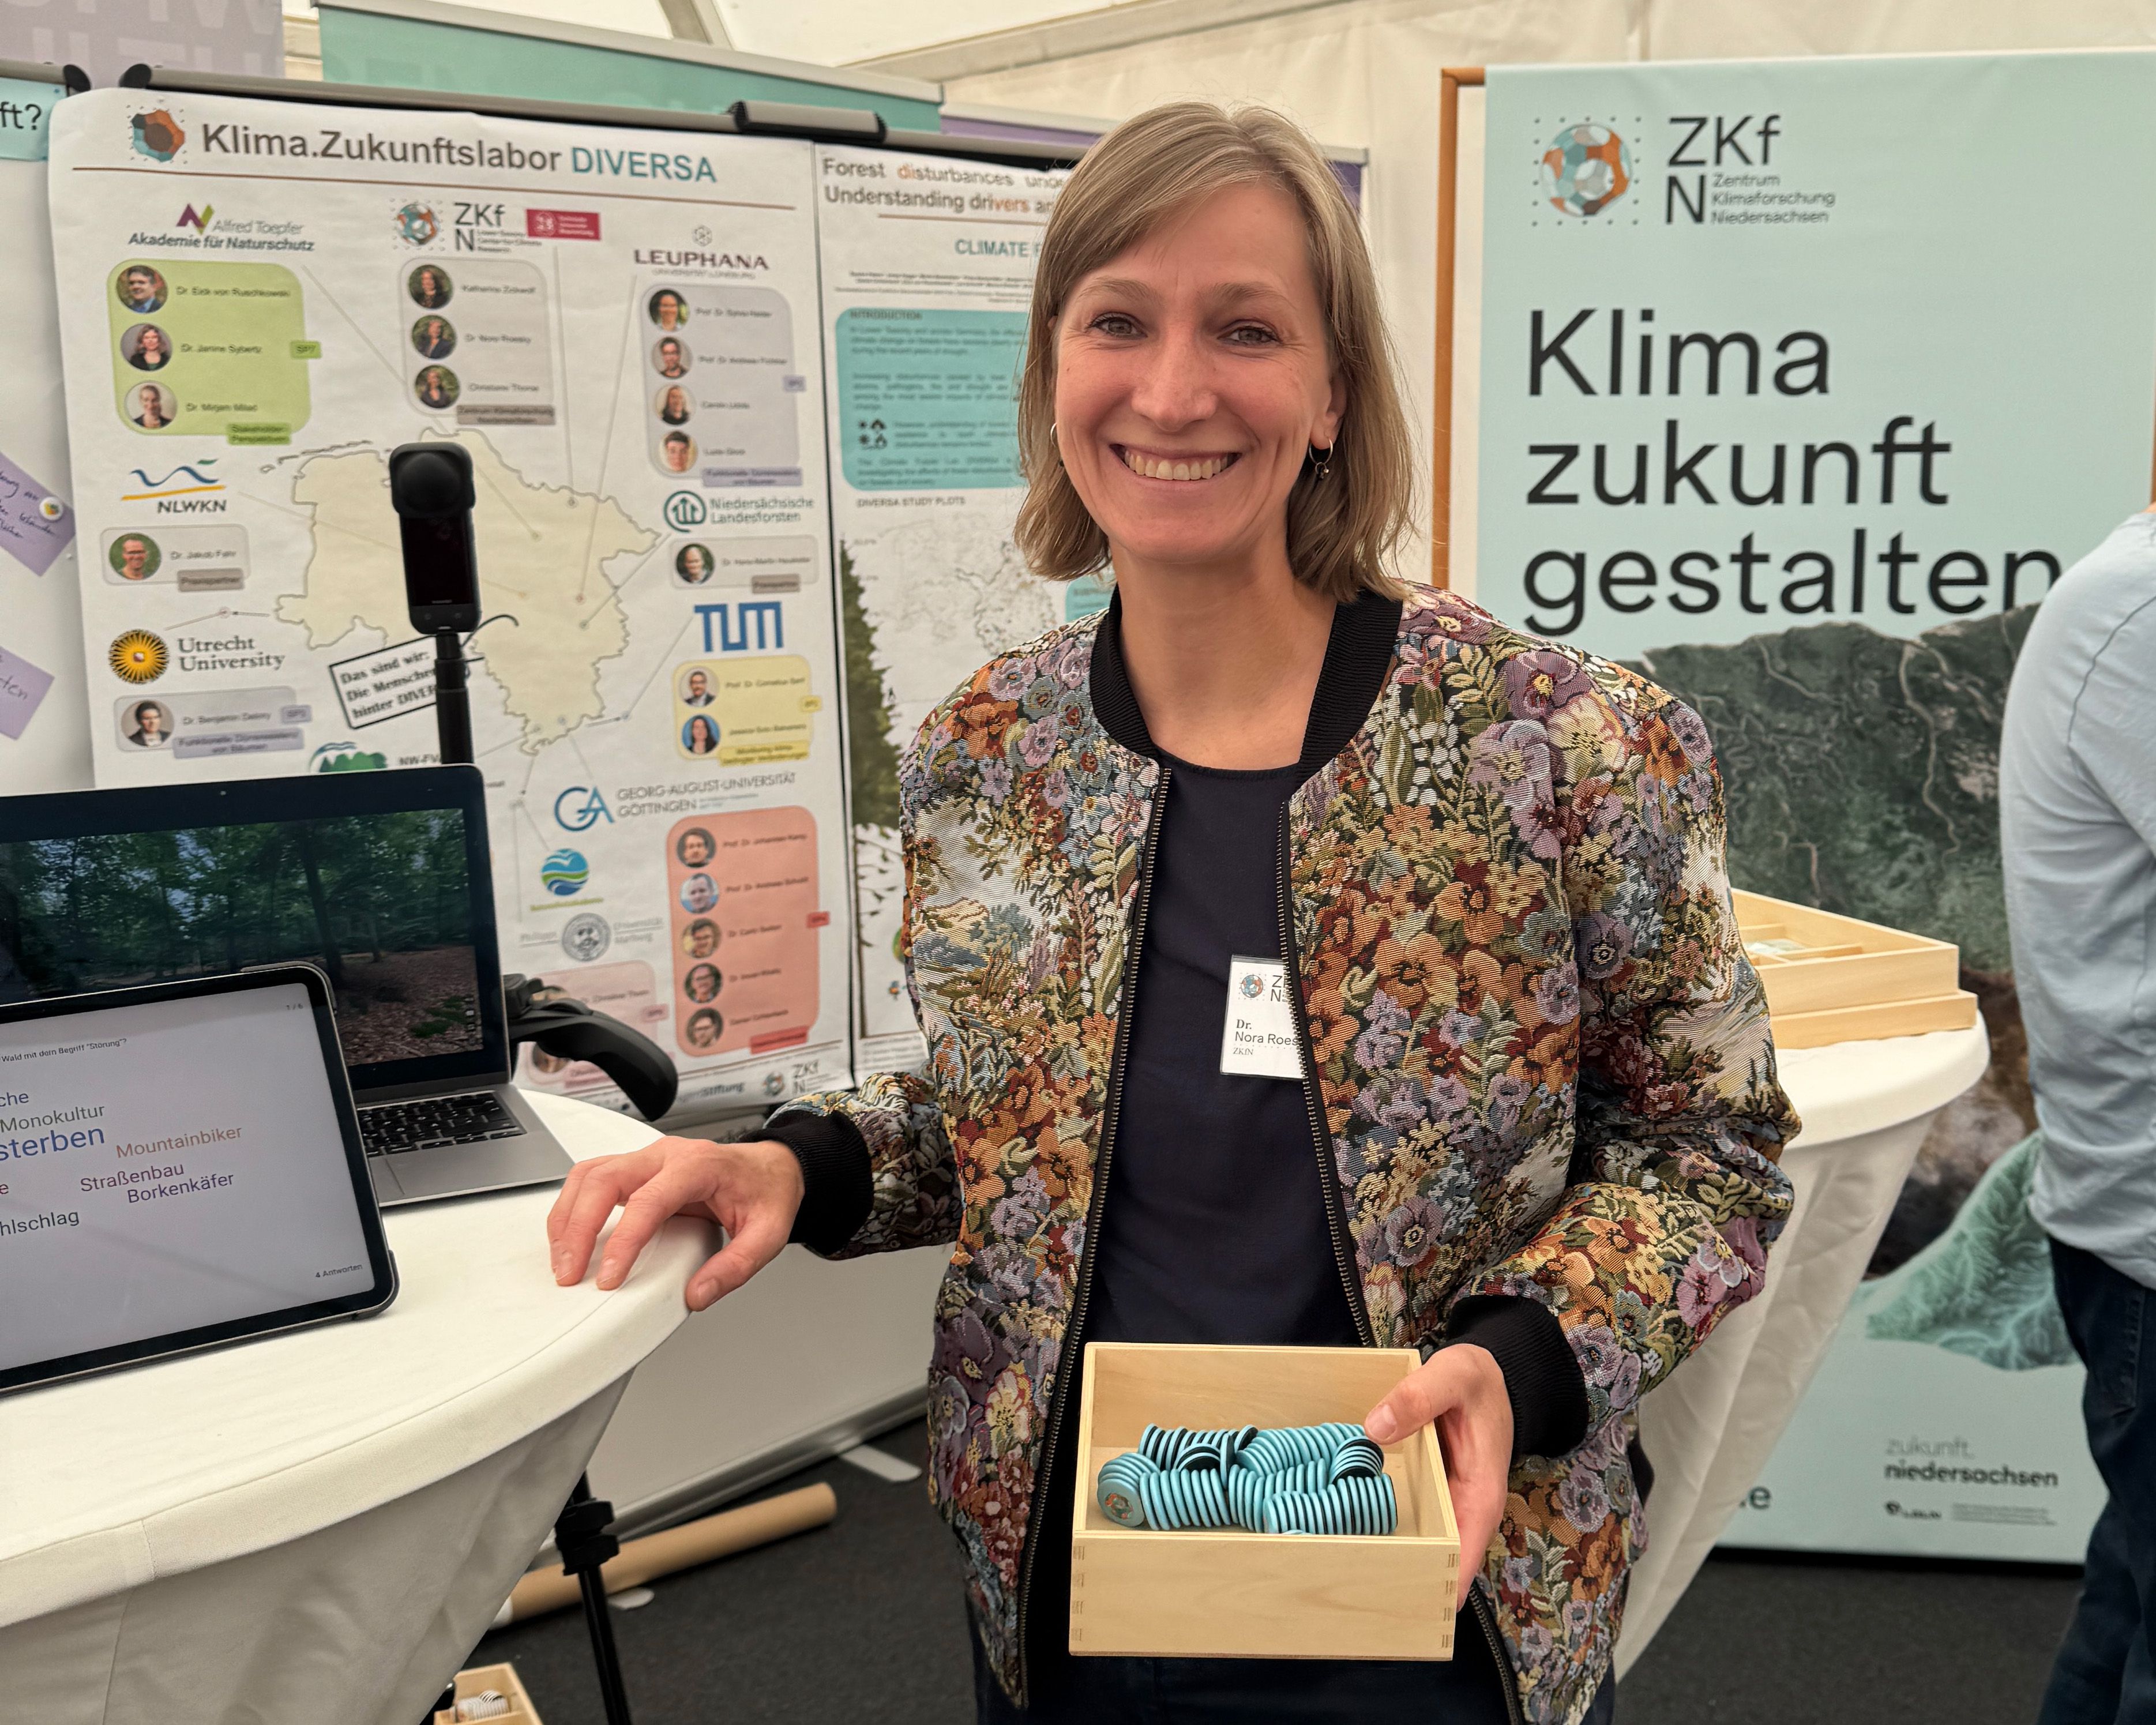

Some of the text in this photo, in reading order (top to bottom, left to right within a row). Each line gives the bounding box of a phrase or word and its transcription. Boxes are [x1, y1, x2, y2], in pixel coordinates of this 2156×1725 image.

[202, 123, 718, 183] Klima.Zukunftslabor DIVERSA
[1667, 115, 1782, 167] ZKf
[822, 157, 886, 179] Forest
[897, 164, 1015, 187] disturbances
[1712, 174, 1781, 188] Zentrum
[824, 185, 966, 213] Understanding
[970, 194, 1030, 213] drivers
[1666, 174, 1706, 225] N
[1711, 191, 1836, 208] Klimaforschung
[213, 219, 253, 234] Alfred
[454, 202, 506, 228] ZKf
[1711, 211, 1829, 225] Niedersachsen
[128, 232, 315, 251] Akademie für Naturschutz
[455, 229, 475, 253] N
[954, 238, 1030, 258] CLIMATE
[634, 249, 771, 271] LEUPHANA
[1527, 307, 1832, 398] Klima
[1526, 415, 1953, 506] zukunft
[157, 499, 227, 514] NLWKN
[1523, 527, 2063, 637] gestalten
[693, 600, 784, 653] TUM
[177, 635, 256, 653] Utrecht
[179, 653, 286, 671] University
[340, 671, 367, 686] Das
[347, 688, 371, 702] Die
[1236, 1019, 1252, 1029] Dr.
[1235, 1031, 1264, 1043] Nora
[2, 1053, 22, 1062] Wald
[24, 1051, 37, 1060] mit
[39, 1049, 57, 1058] dem
[58, 1044, 85, 1055] Begriff
[0, 1104, 105, 1133] Monokultur
[0, 1126, 243, 1162] sterben Mountainbiker
[80, 1163, 185, 1192] Straßenbau
[127, 1172, 235, 1204] Borkenkäfer
[0, 1211, 80, 1237] hlschlag
[322, 1264, 363, 1277] Antworten
[1884, 1459, 2059, 1487] niedersachsen
